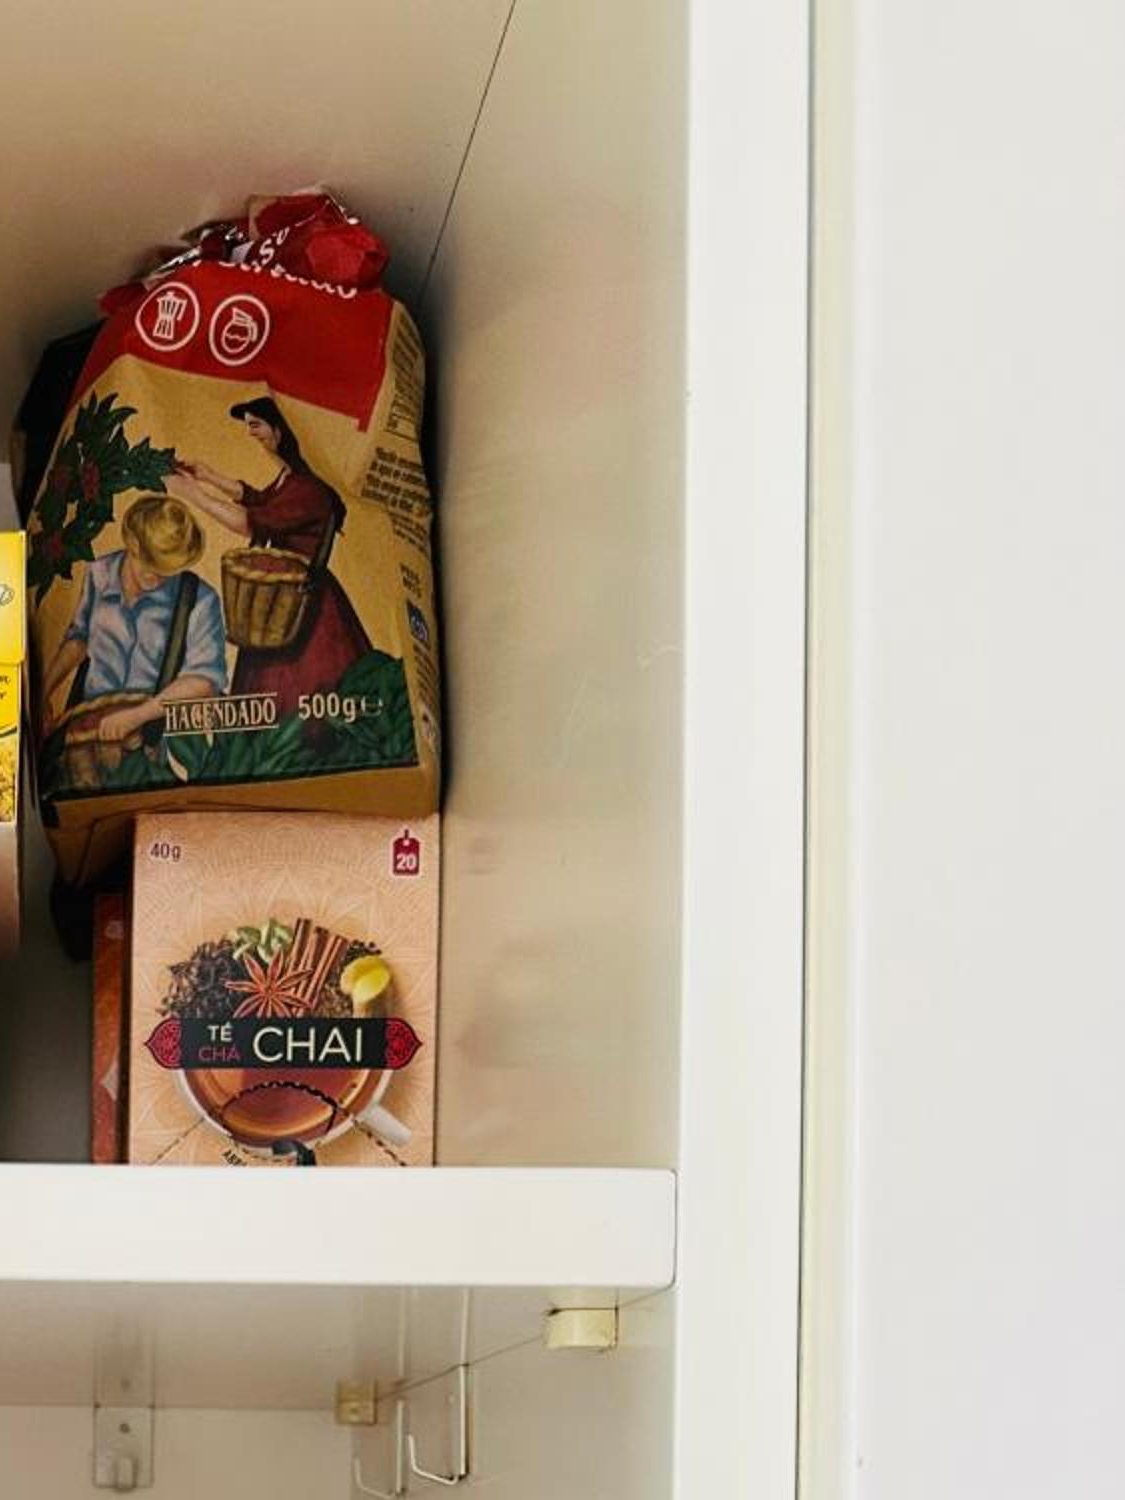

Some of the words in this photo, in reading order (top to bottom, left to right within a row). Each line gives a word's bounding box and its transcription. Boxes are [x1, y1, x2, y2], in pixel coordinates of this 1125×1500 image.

[166, 698, 276, 730] HACENDADO
[298, 692, 356, 723] 500g
[396, 853, 417, 870] 20
[207, 1021, 233, 1042] TÉ
[252, 1027, 363, 1062] CHAI
